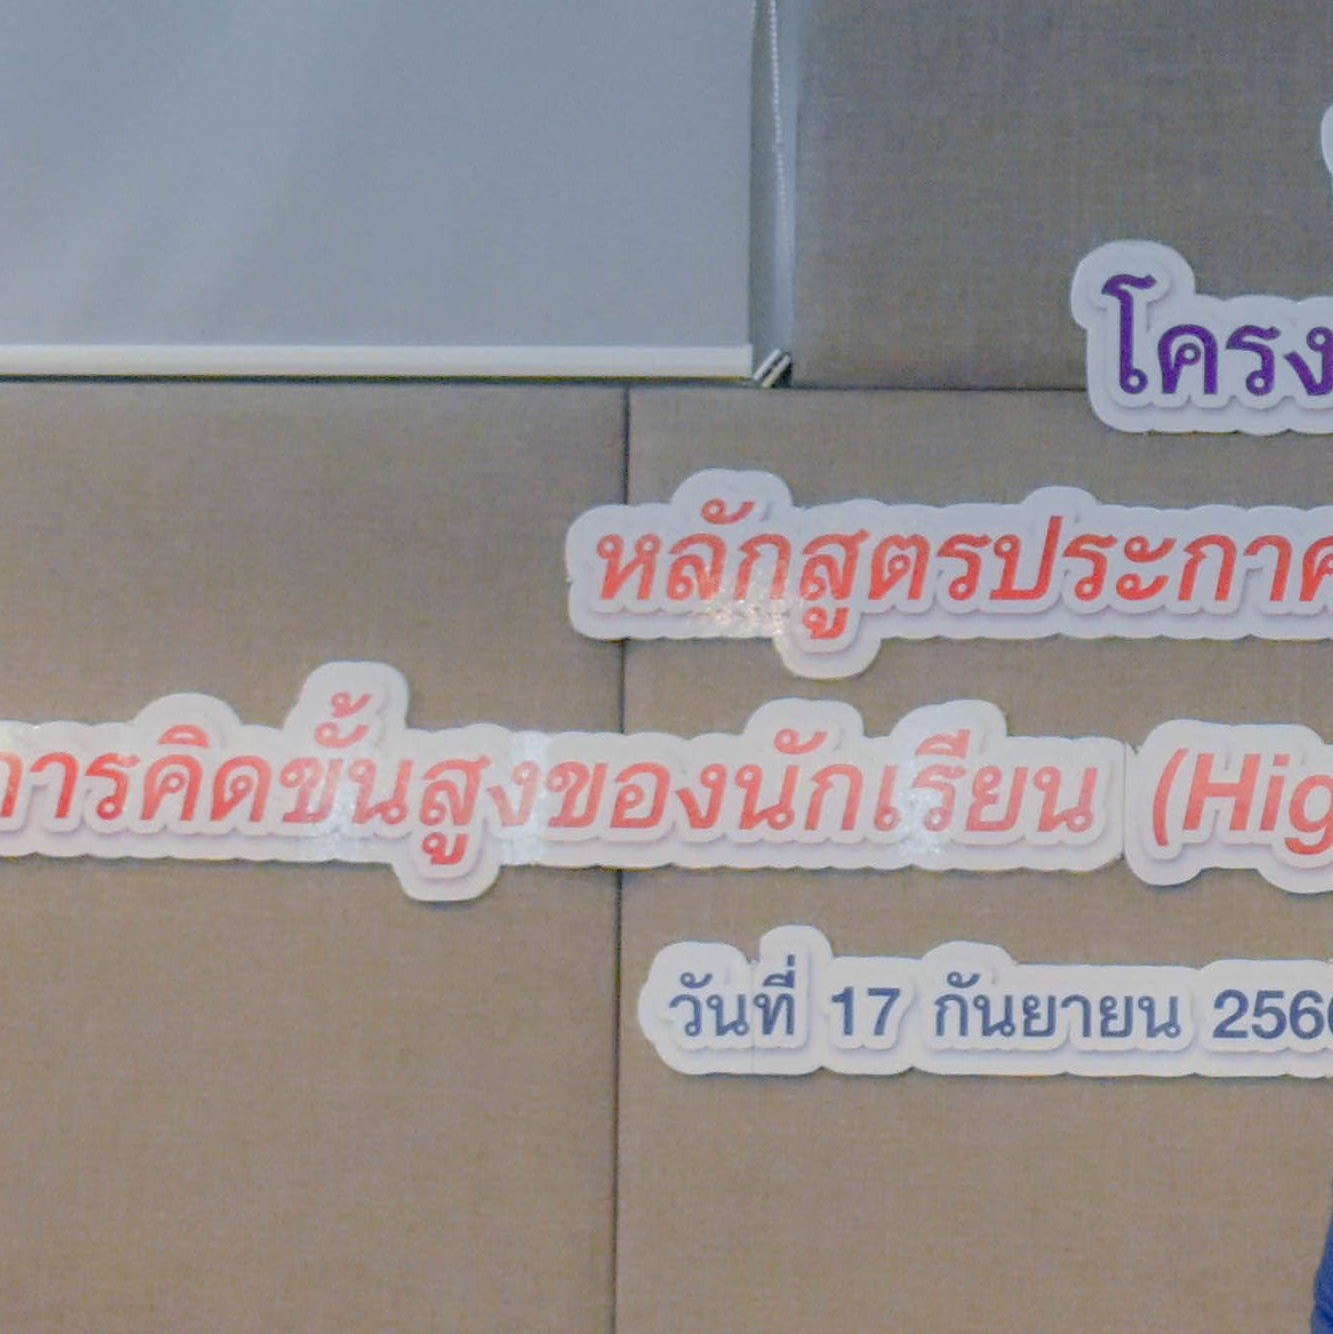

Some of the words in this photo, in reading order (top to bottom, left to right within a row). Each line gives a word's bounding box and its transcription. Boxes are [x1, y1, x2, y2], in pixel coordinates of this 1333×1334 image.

[670, 970, 795, 1036] วันที่
[832, 987, 899, 1036] 17
[936, 973, 1180, 1038] กันยายน
